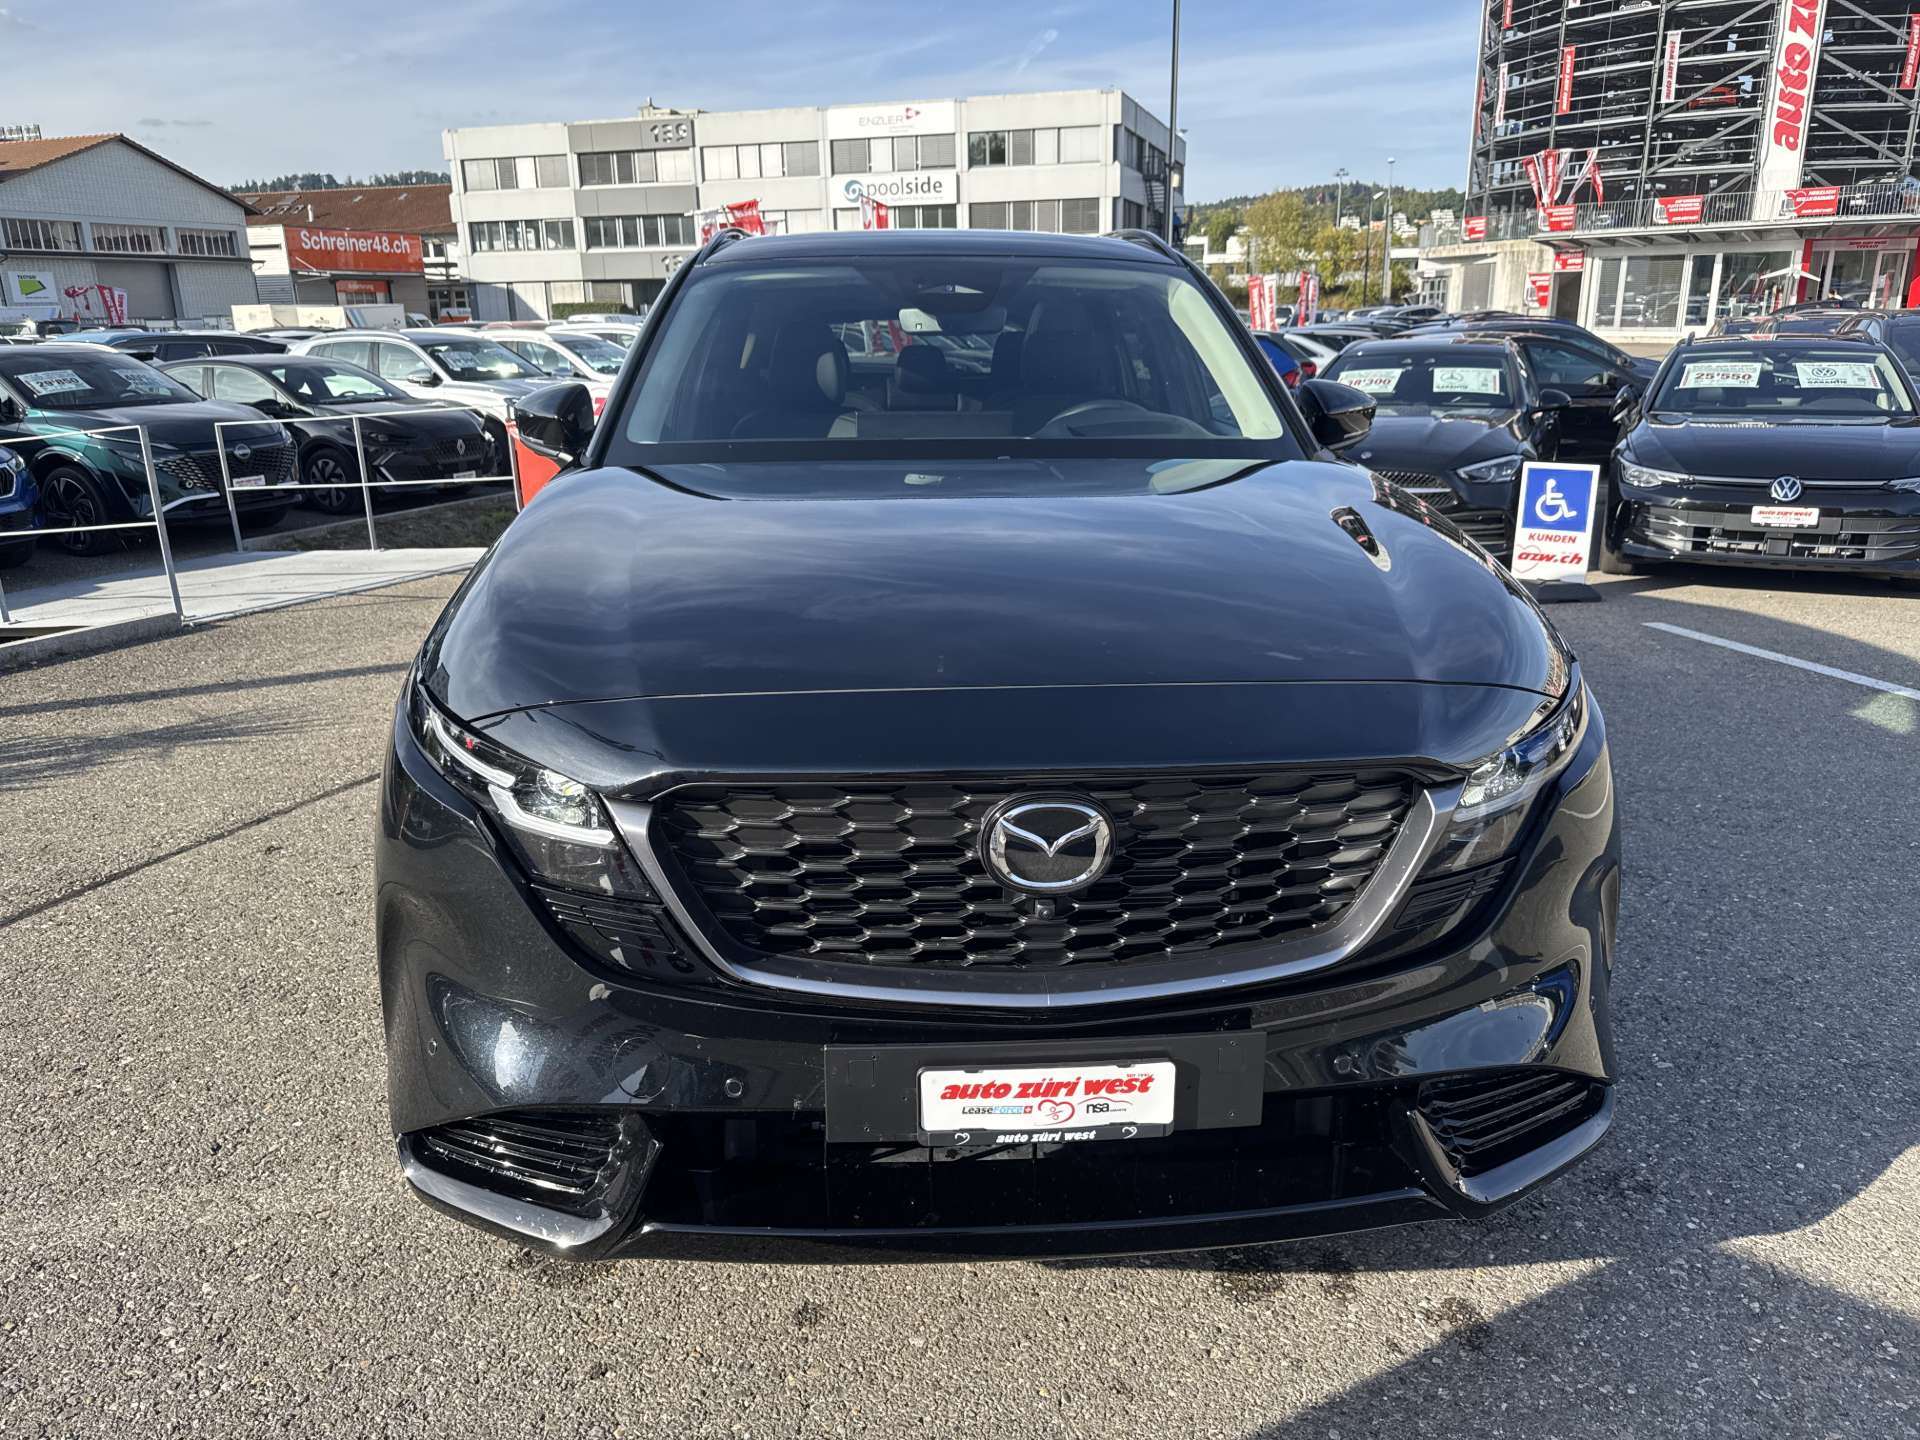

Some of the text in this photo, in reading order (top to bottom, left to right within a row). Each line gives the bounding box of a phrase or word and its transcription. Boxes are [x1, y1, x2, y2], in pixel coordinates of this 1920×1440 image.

[1774, 43, 1811, 151] auto
[866, 175, 943, 197] poolside
[300, 229, 411, 254] Schreiner48.ch
[1528, 532, 1577, 544] KUNDEN
[1517, 551, 1583, 565] azw.ch
[940, 1076, 1155, 1100] auto züri west
[961, 1105, 1023, 1115] LeaseForce
[1086, 1102, 1110, 1114] nsa
[996, 1130, 1097, 1144] auto züri west
